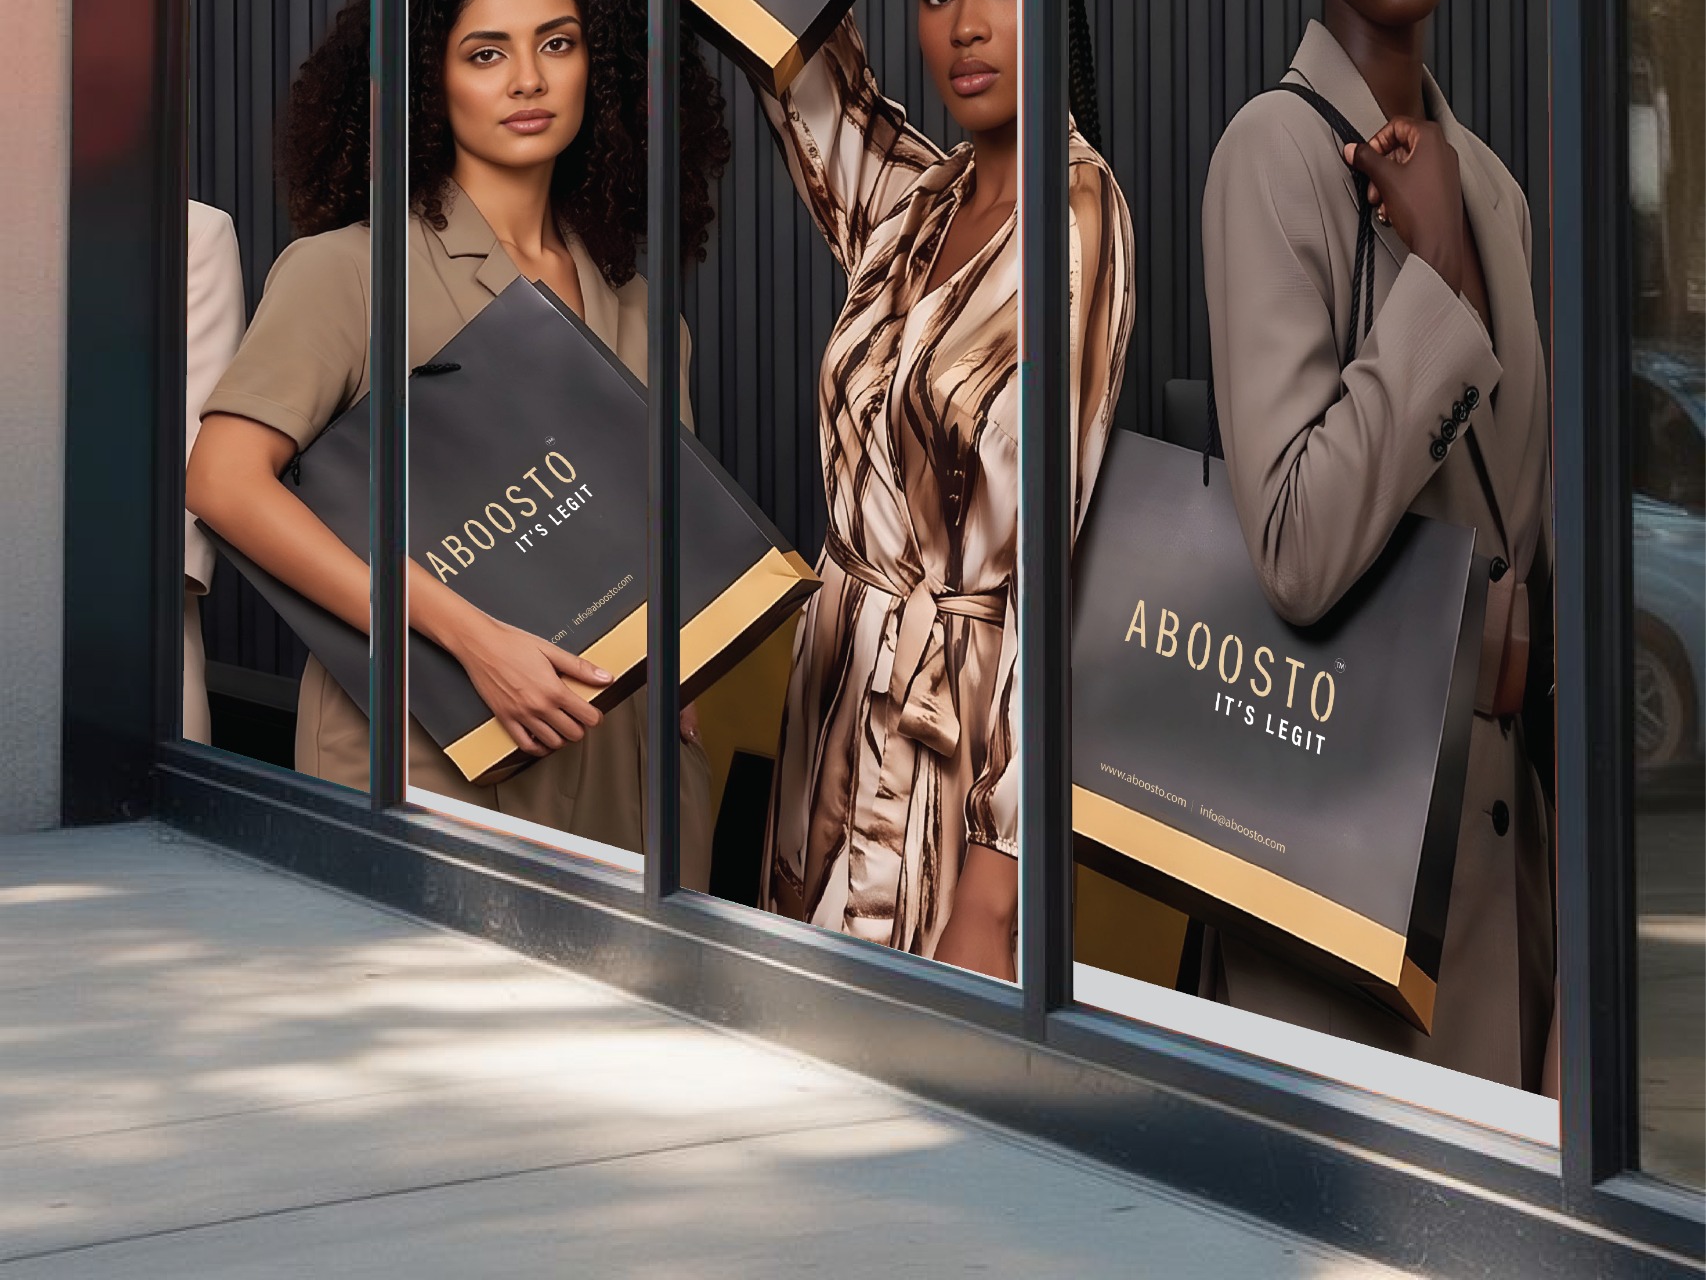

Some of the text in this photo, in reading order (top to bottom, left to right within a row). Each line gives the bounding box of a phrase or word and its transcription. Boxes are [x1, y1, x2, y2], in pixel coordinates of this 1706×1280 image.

[426, 451, 577, 583] ABOOSTO
[514, 484, 593, 553] IT'S LEGIT
[572, 573, 634, 626] info@aboosto.com
[1124, 599, 1336, 722] ABOOSTO
[1215, 692, 1326, 755] IT'S LEGIT
[1100, 761, 1286, 853] www.aboosto.com info@aboosto.com
